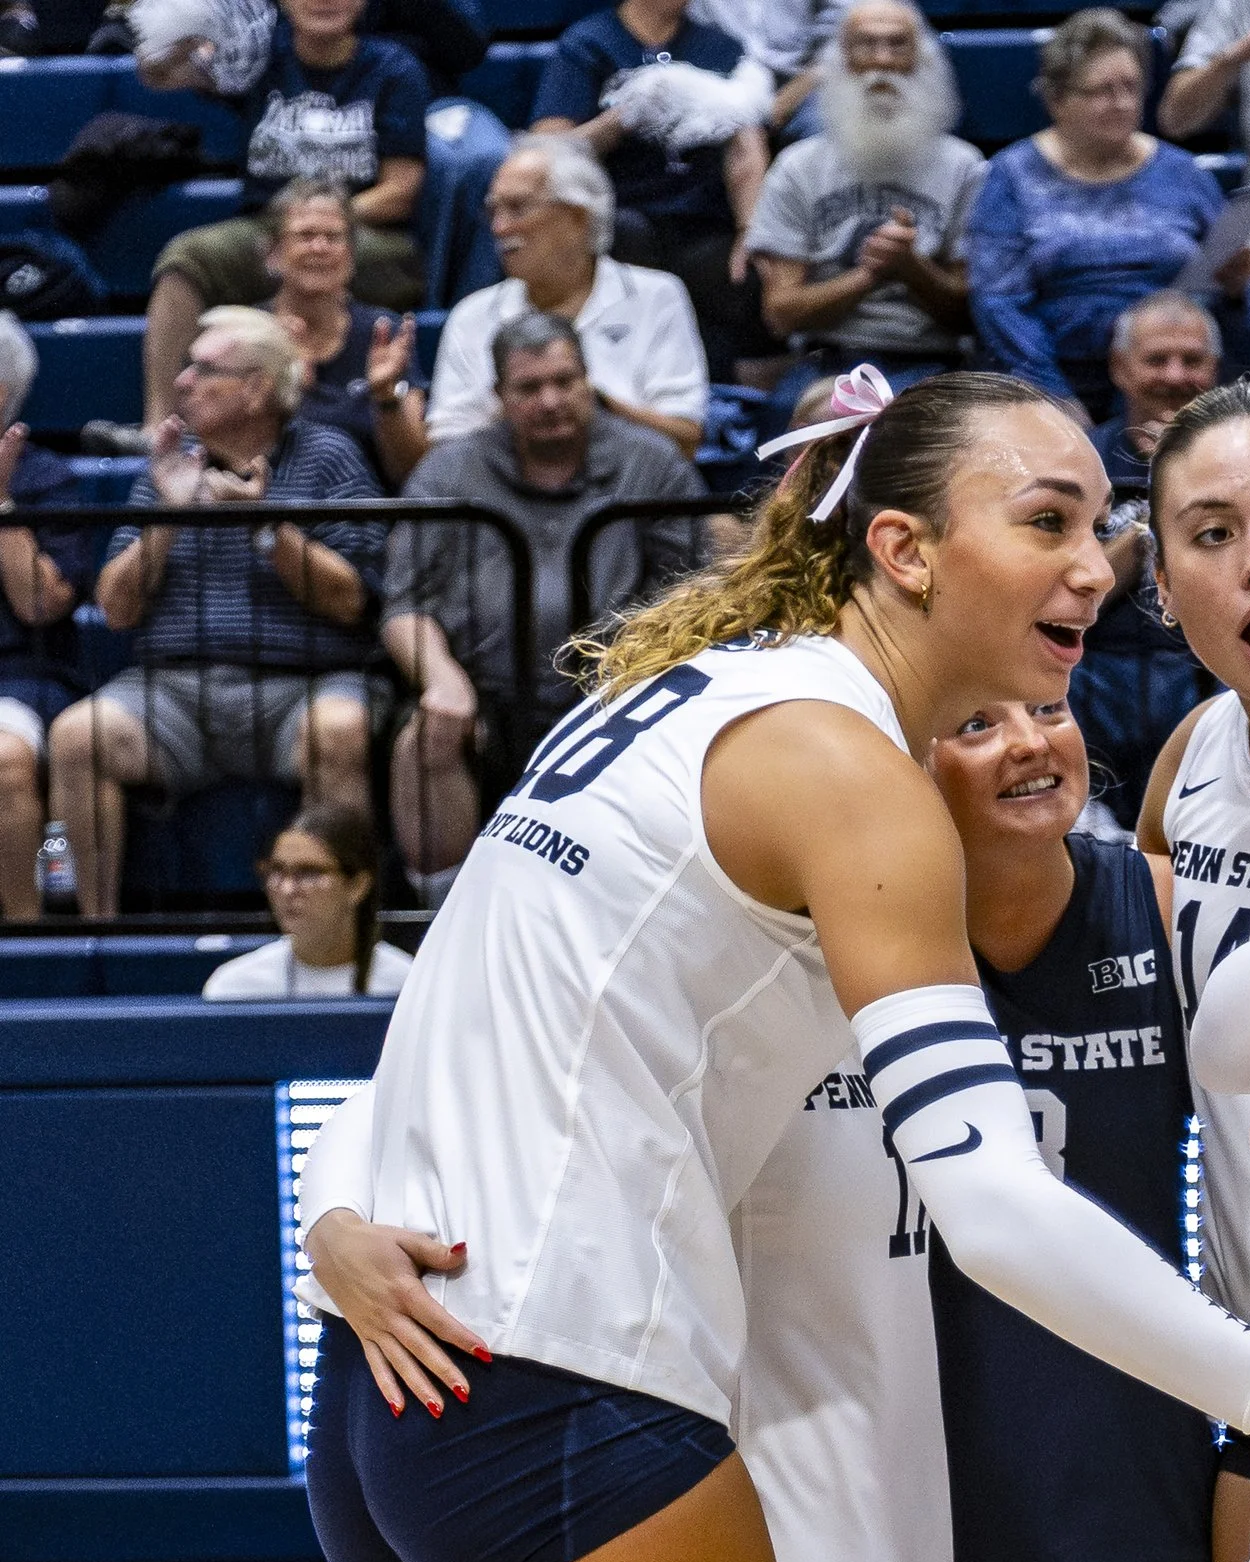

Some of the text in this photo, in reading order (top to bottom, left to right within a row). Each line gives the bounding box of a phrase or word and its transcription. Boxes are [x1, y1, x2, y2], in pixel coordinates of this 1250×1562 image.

[504, 816, 590, 876] LIONS
[1171, 841, 1226, 884] ENN
[1020, 1026, 1166, 1071] STATE
